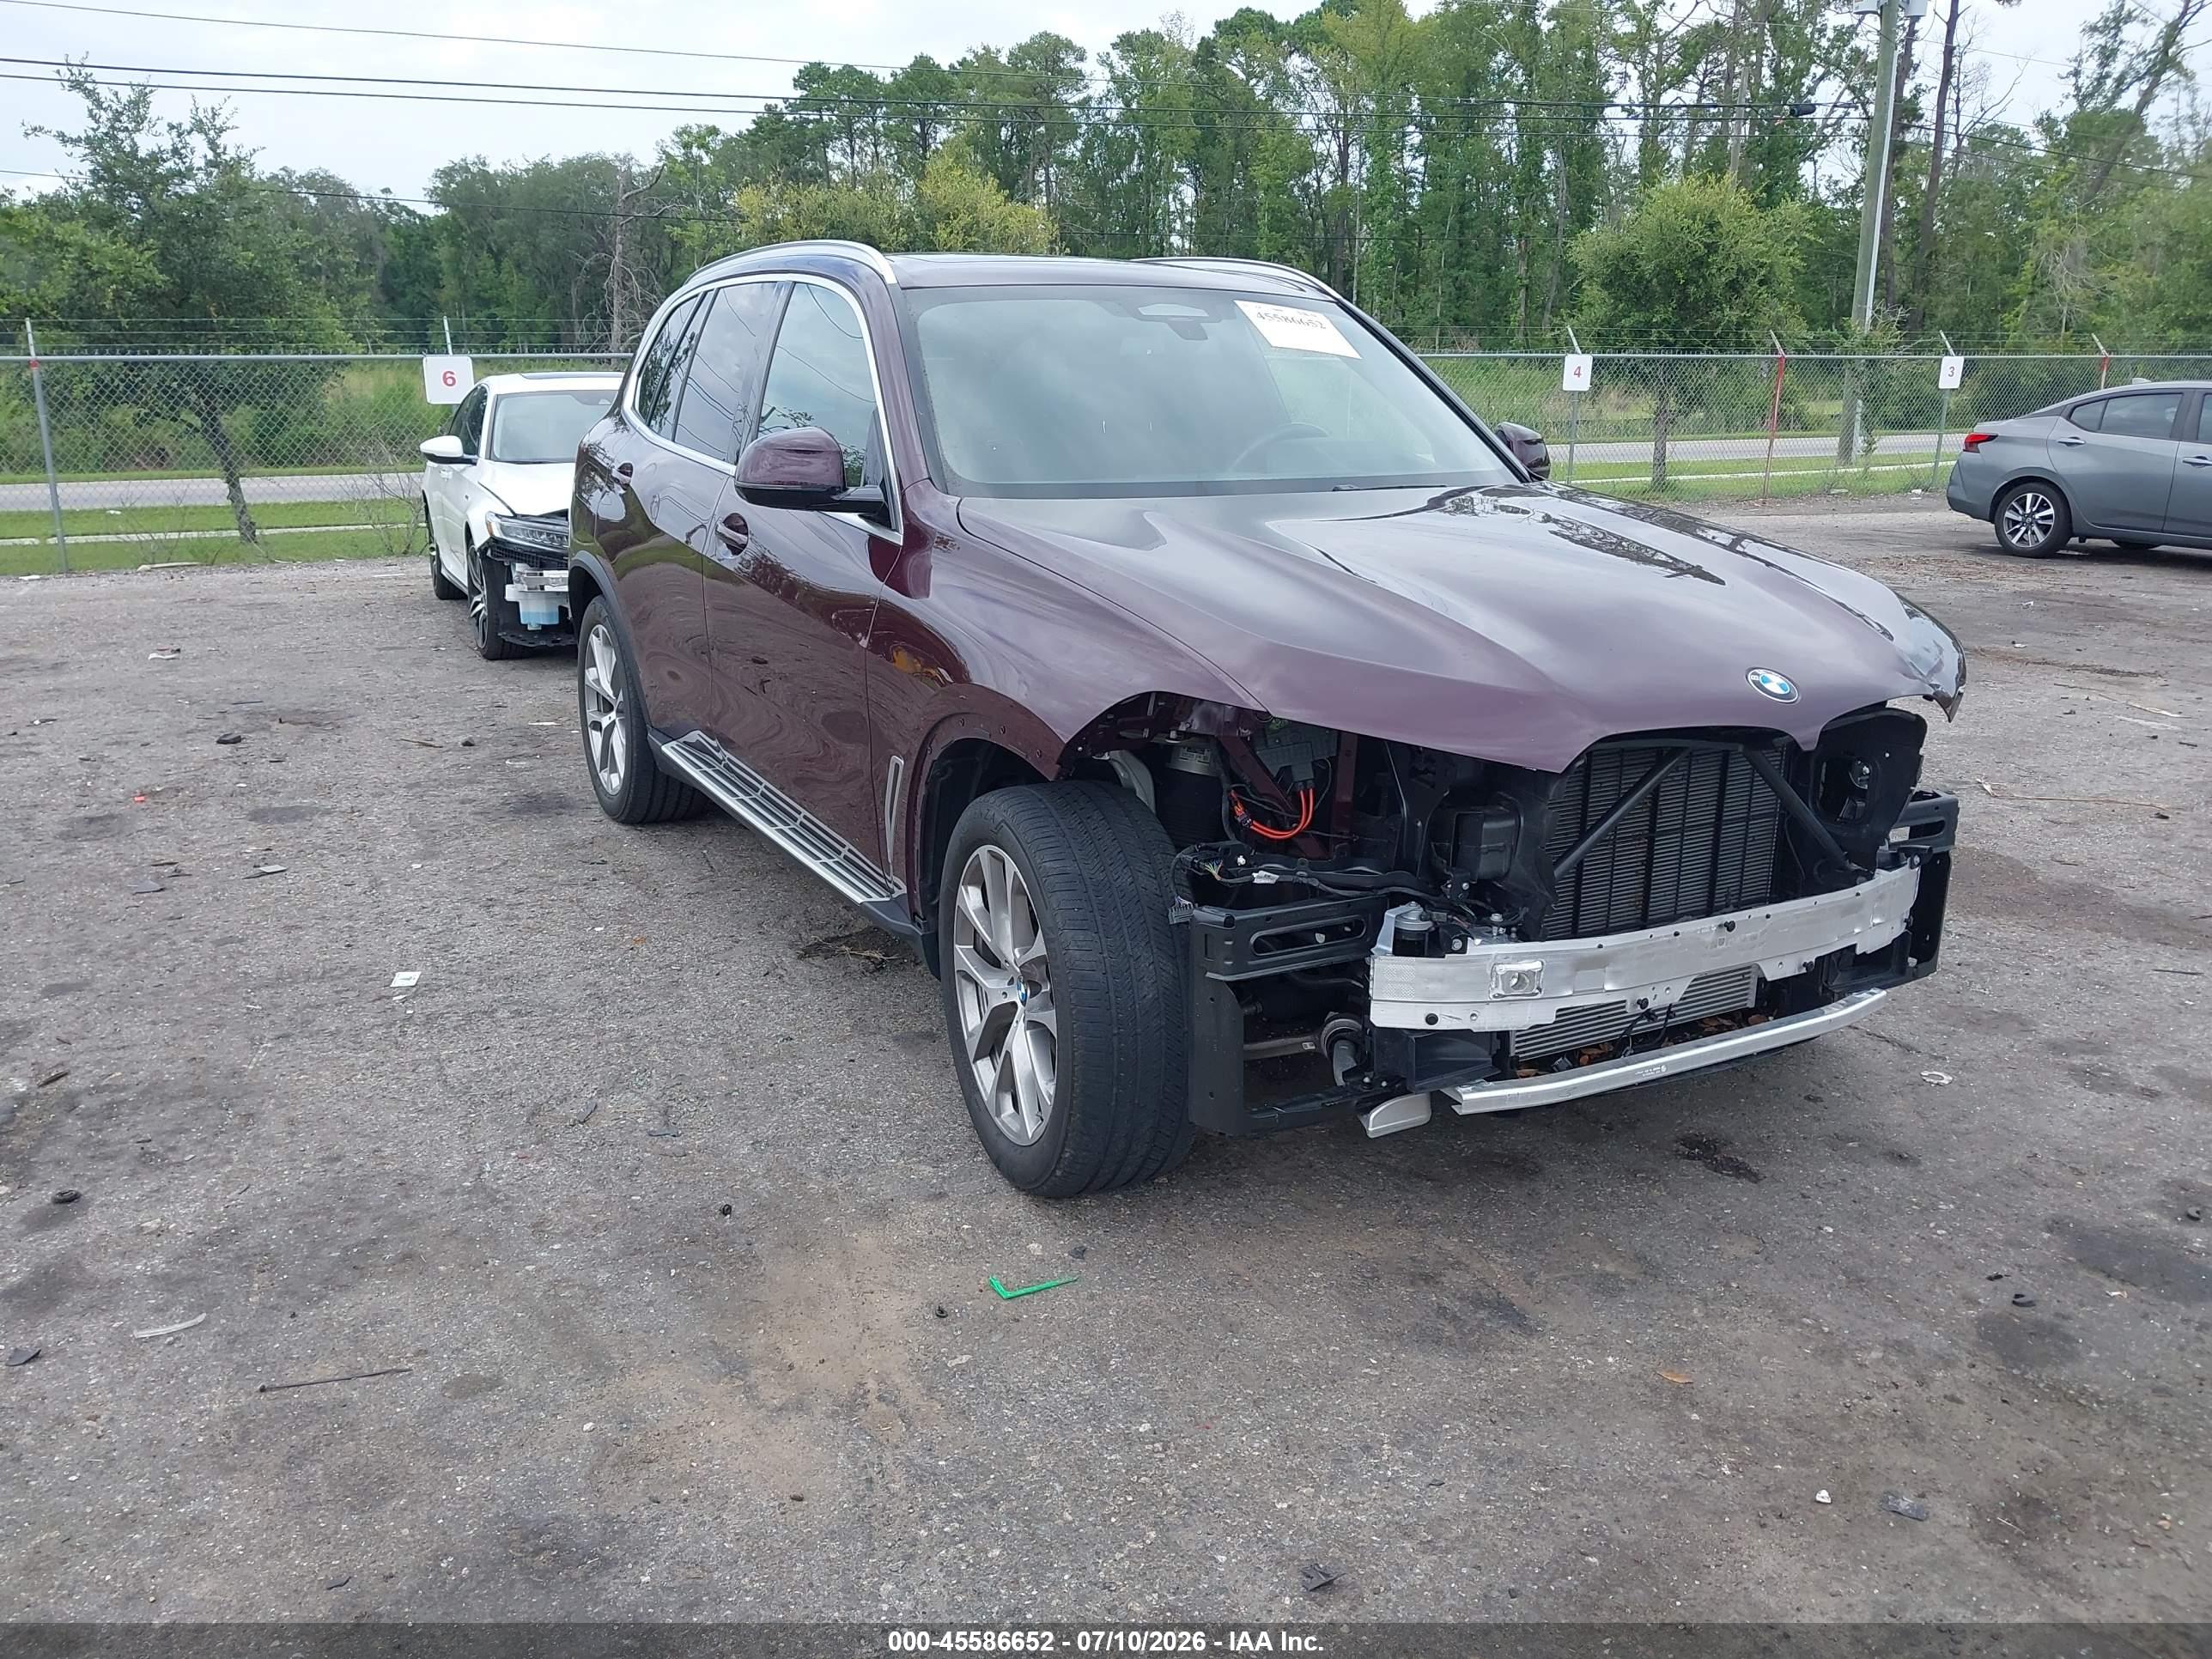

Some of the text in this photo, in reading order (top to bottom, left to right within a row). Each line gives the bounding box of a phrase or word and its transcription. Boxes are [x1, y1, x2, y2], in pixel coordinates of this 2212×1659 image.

[1573, 366, 1583, 378] 4
[1948, 366, 1955, 378] 3
[441, 370, 457, 387] 6
